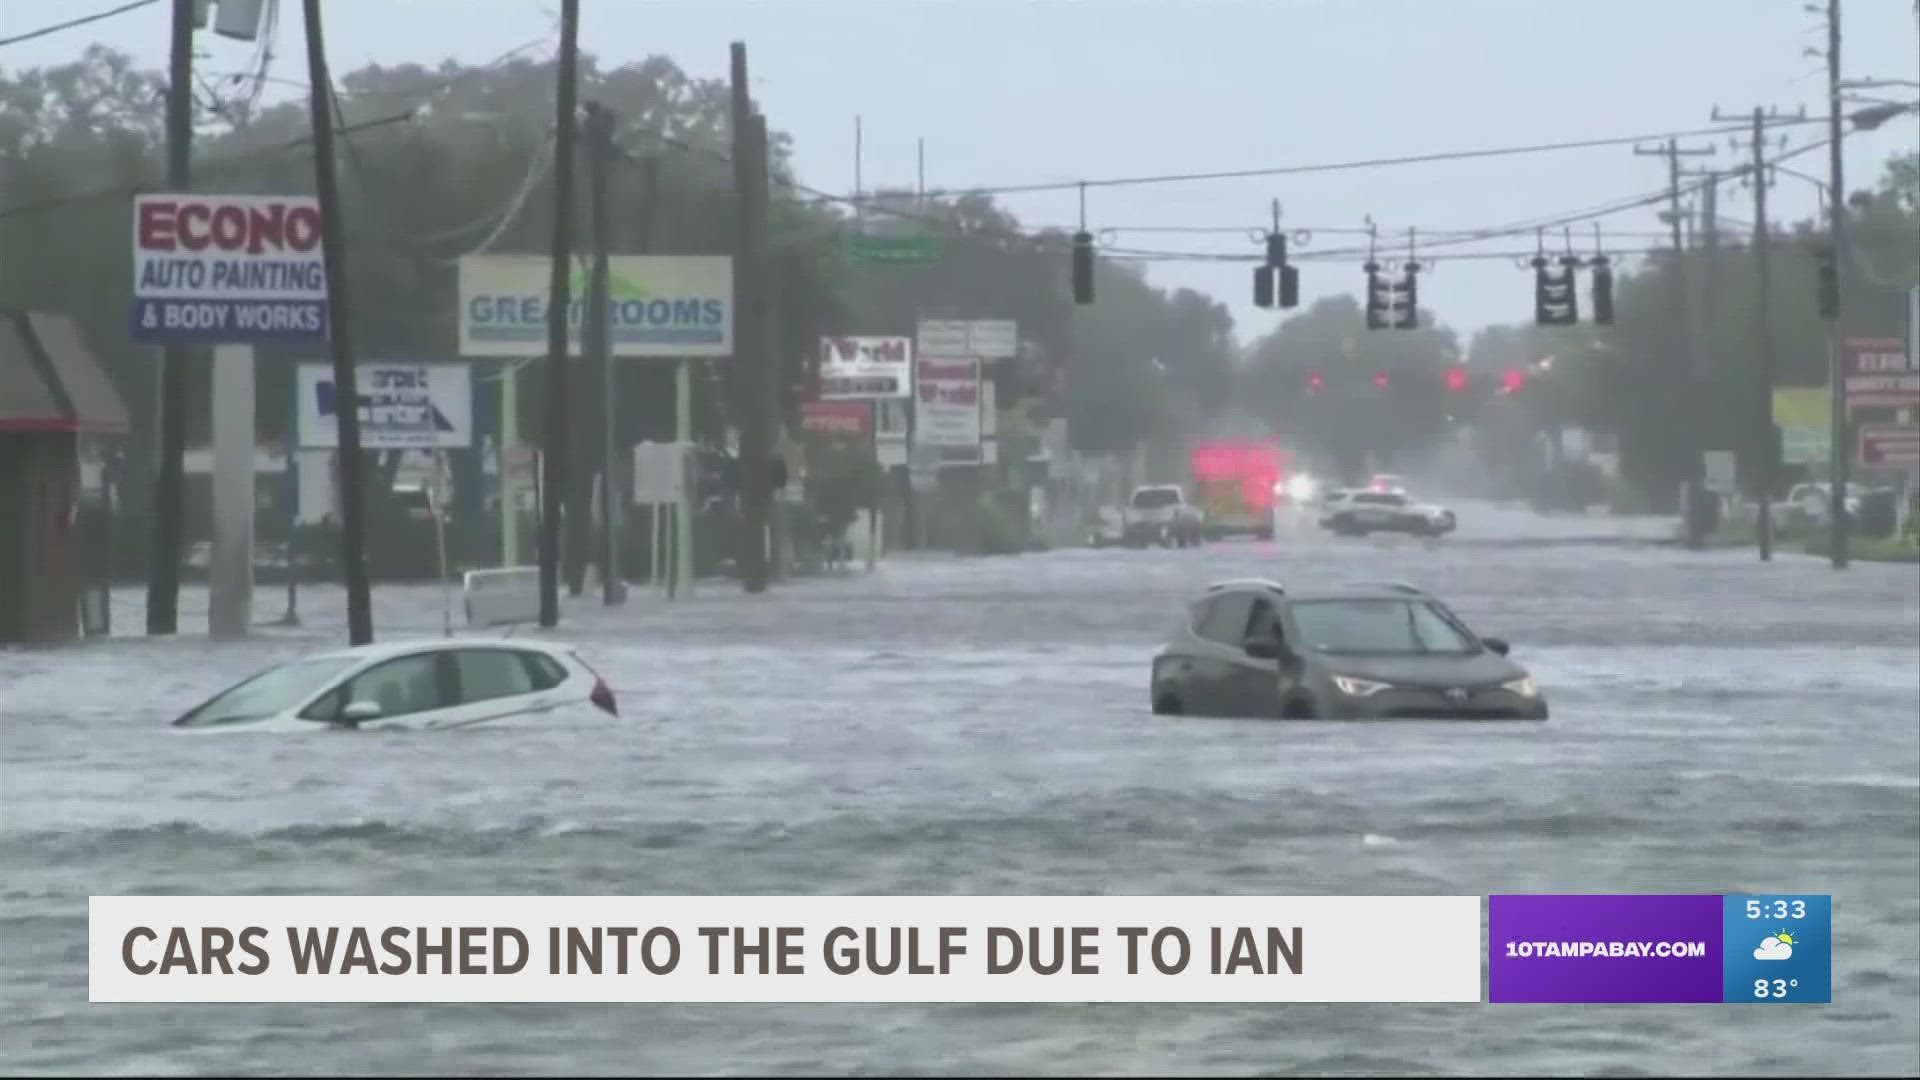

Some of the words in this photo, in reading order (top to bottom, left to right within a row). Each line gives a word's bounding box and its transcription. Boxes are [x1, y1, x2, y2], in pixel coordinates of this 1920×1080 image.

[138, 202, 321, 254] ECONO
[141, 260, 204, 289] AUTO
[212, 260, 322, 290] PAINTING
[142, 304, 157, 328] &
[164, 304, 229, 328] BODY
[235, 304, 320, 330] WORKS
